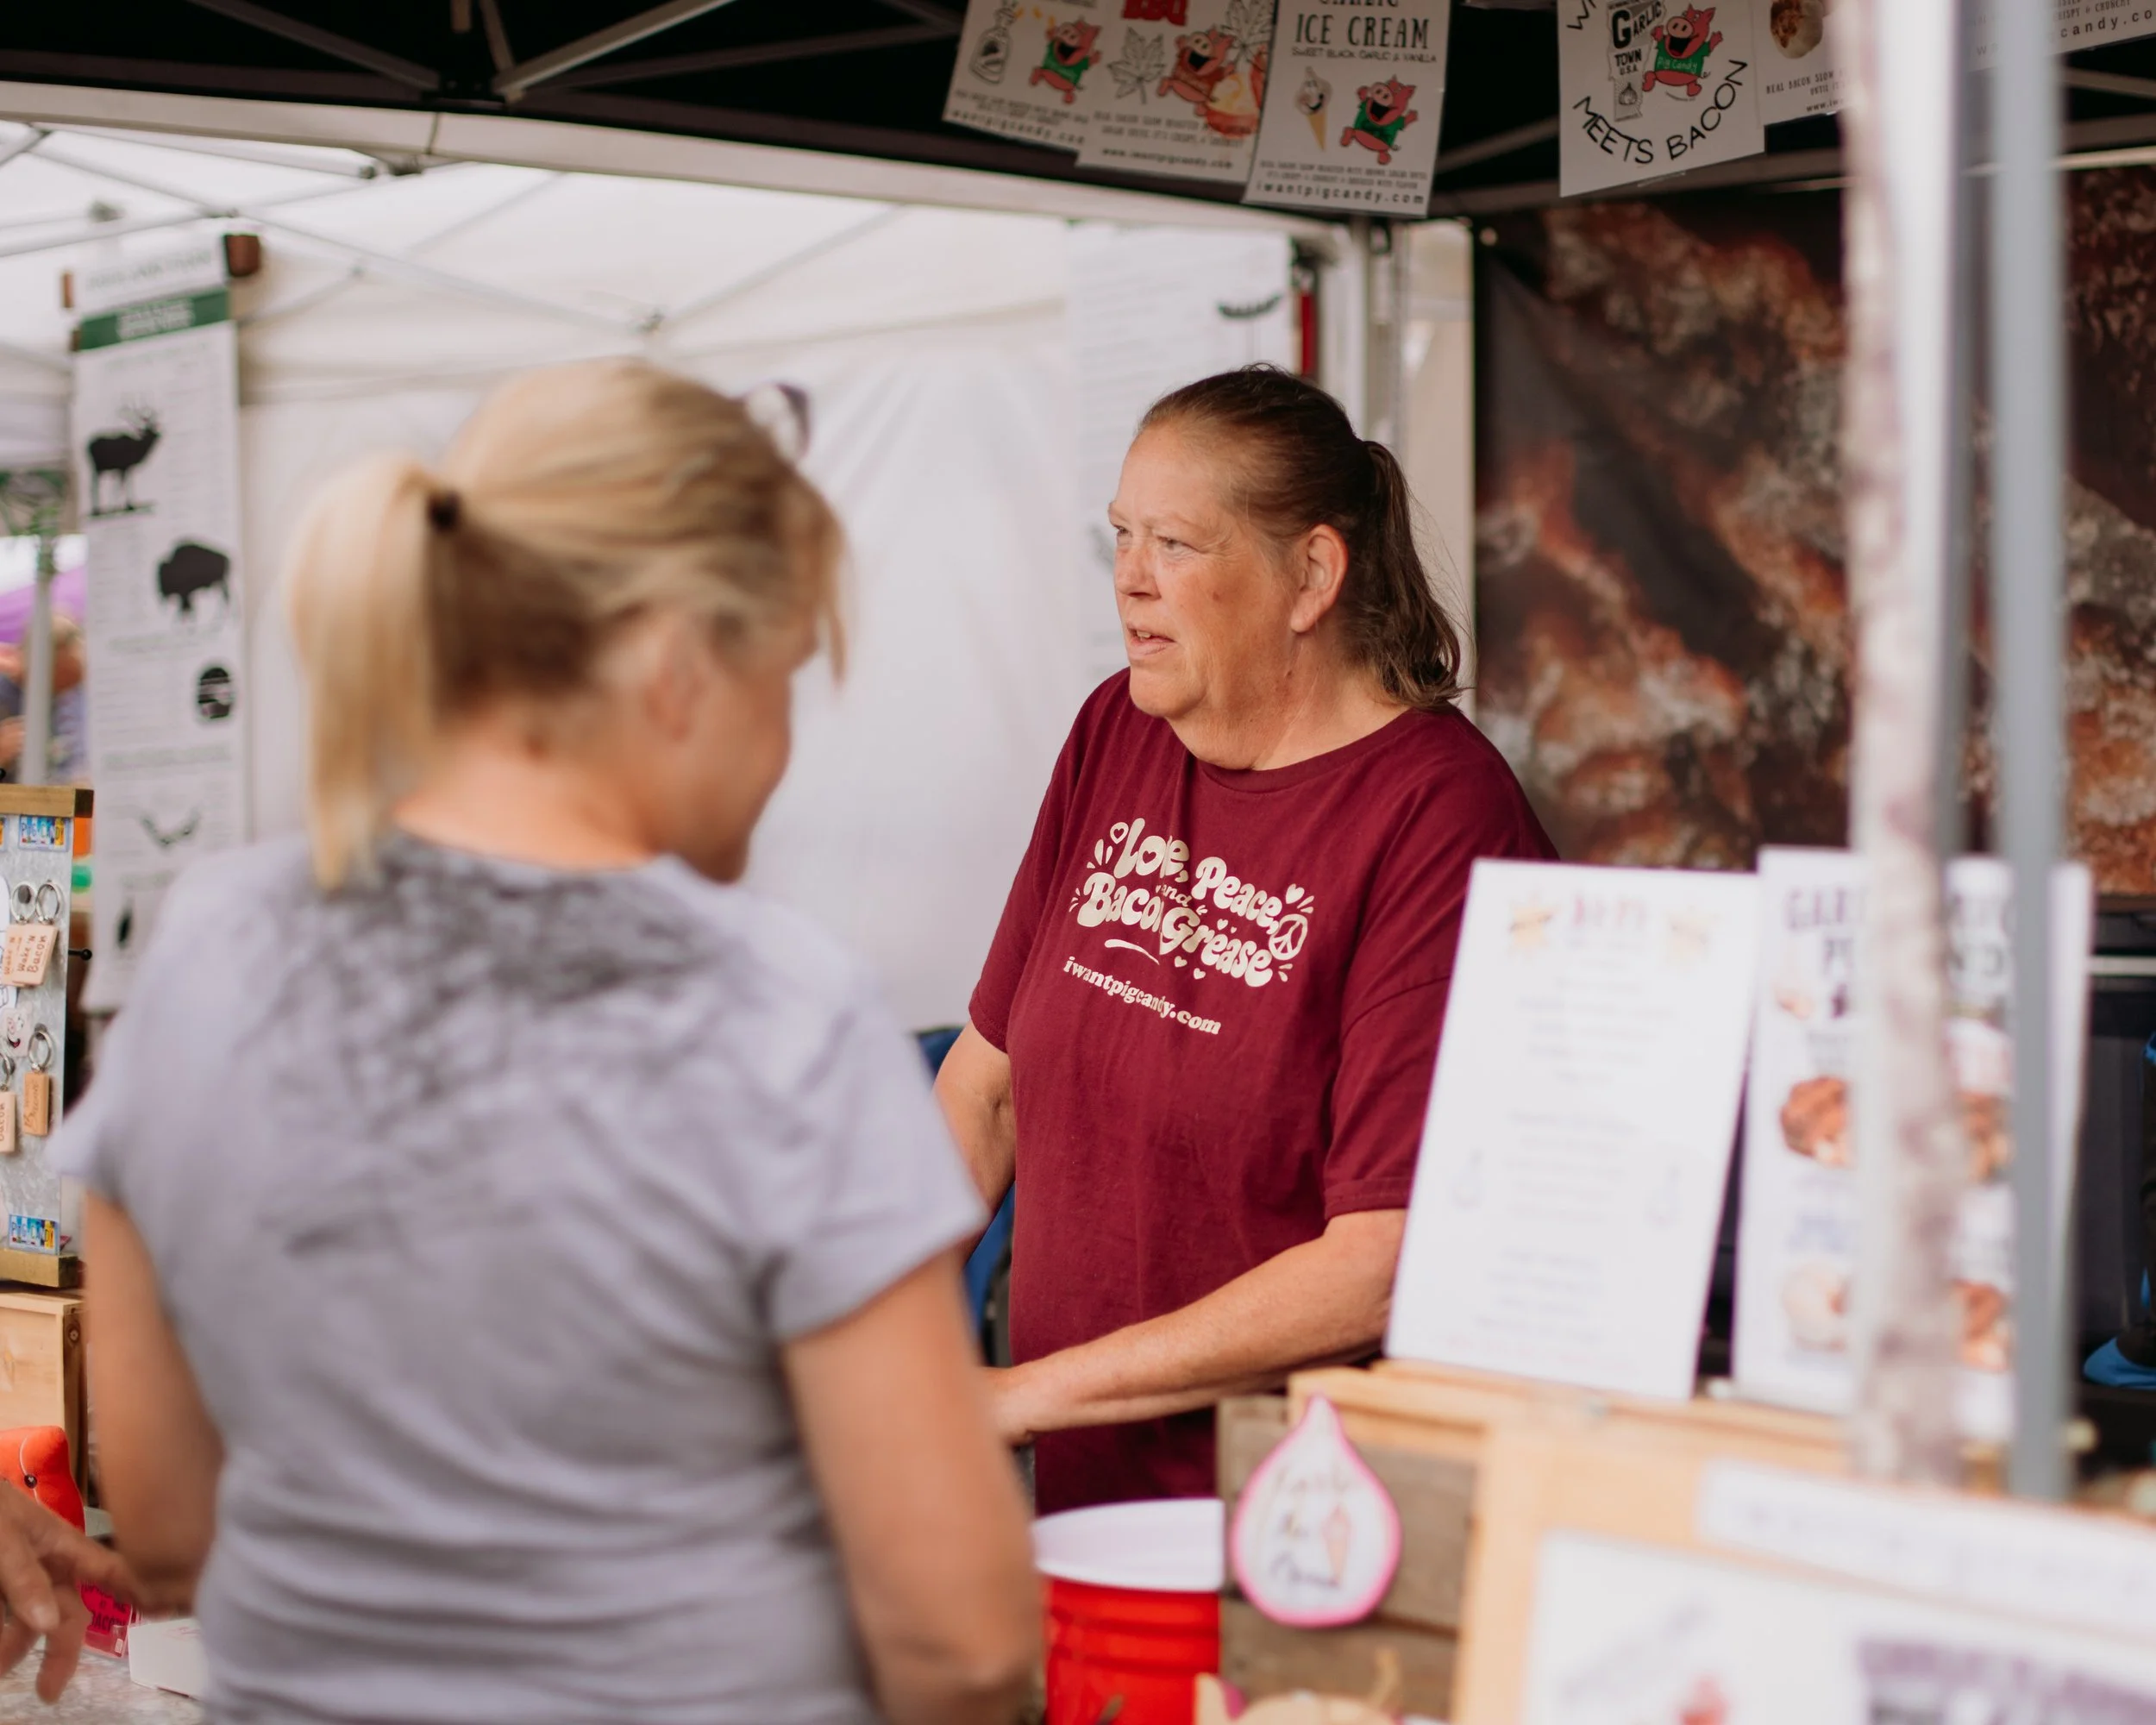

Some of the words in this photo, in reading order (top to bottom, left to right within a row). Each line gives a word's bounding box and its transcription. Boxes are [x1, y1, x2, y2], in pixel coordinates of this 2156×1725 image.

[1295, 13, 1334, 44] ICE
[1348, 16, 1429, 49] CREAM
[1614, 48, 1642, 67] TOWN
[1572, 96, 1654, 164] MEETS
[1666, 60, 1748, 160] BACON
[27, 935, 47, 973] Bacon
[1160, 906, 1274, 988] Grease
[1063, 956, 1222, 1035] iwantpigcandy.com
